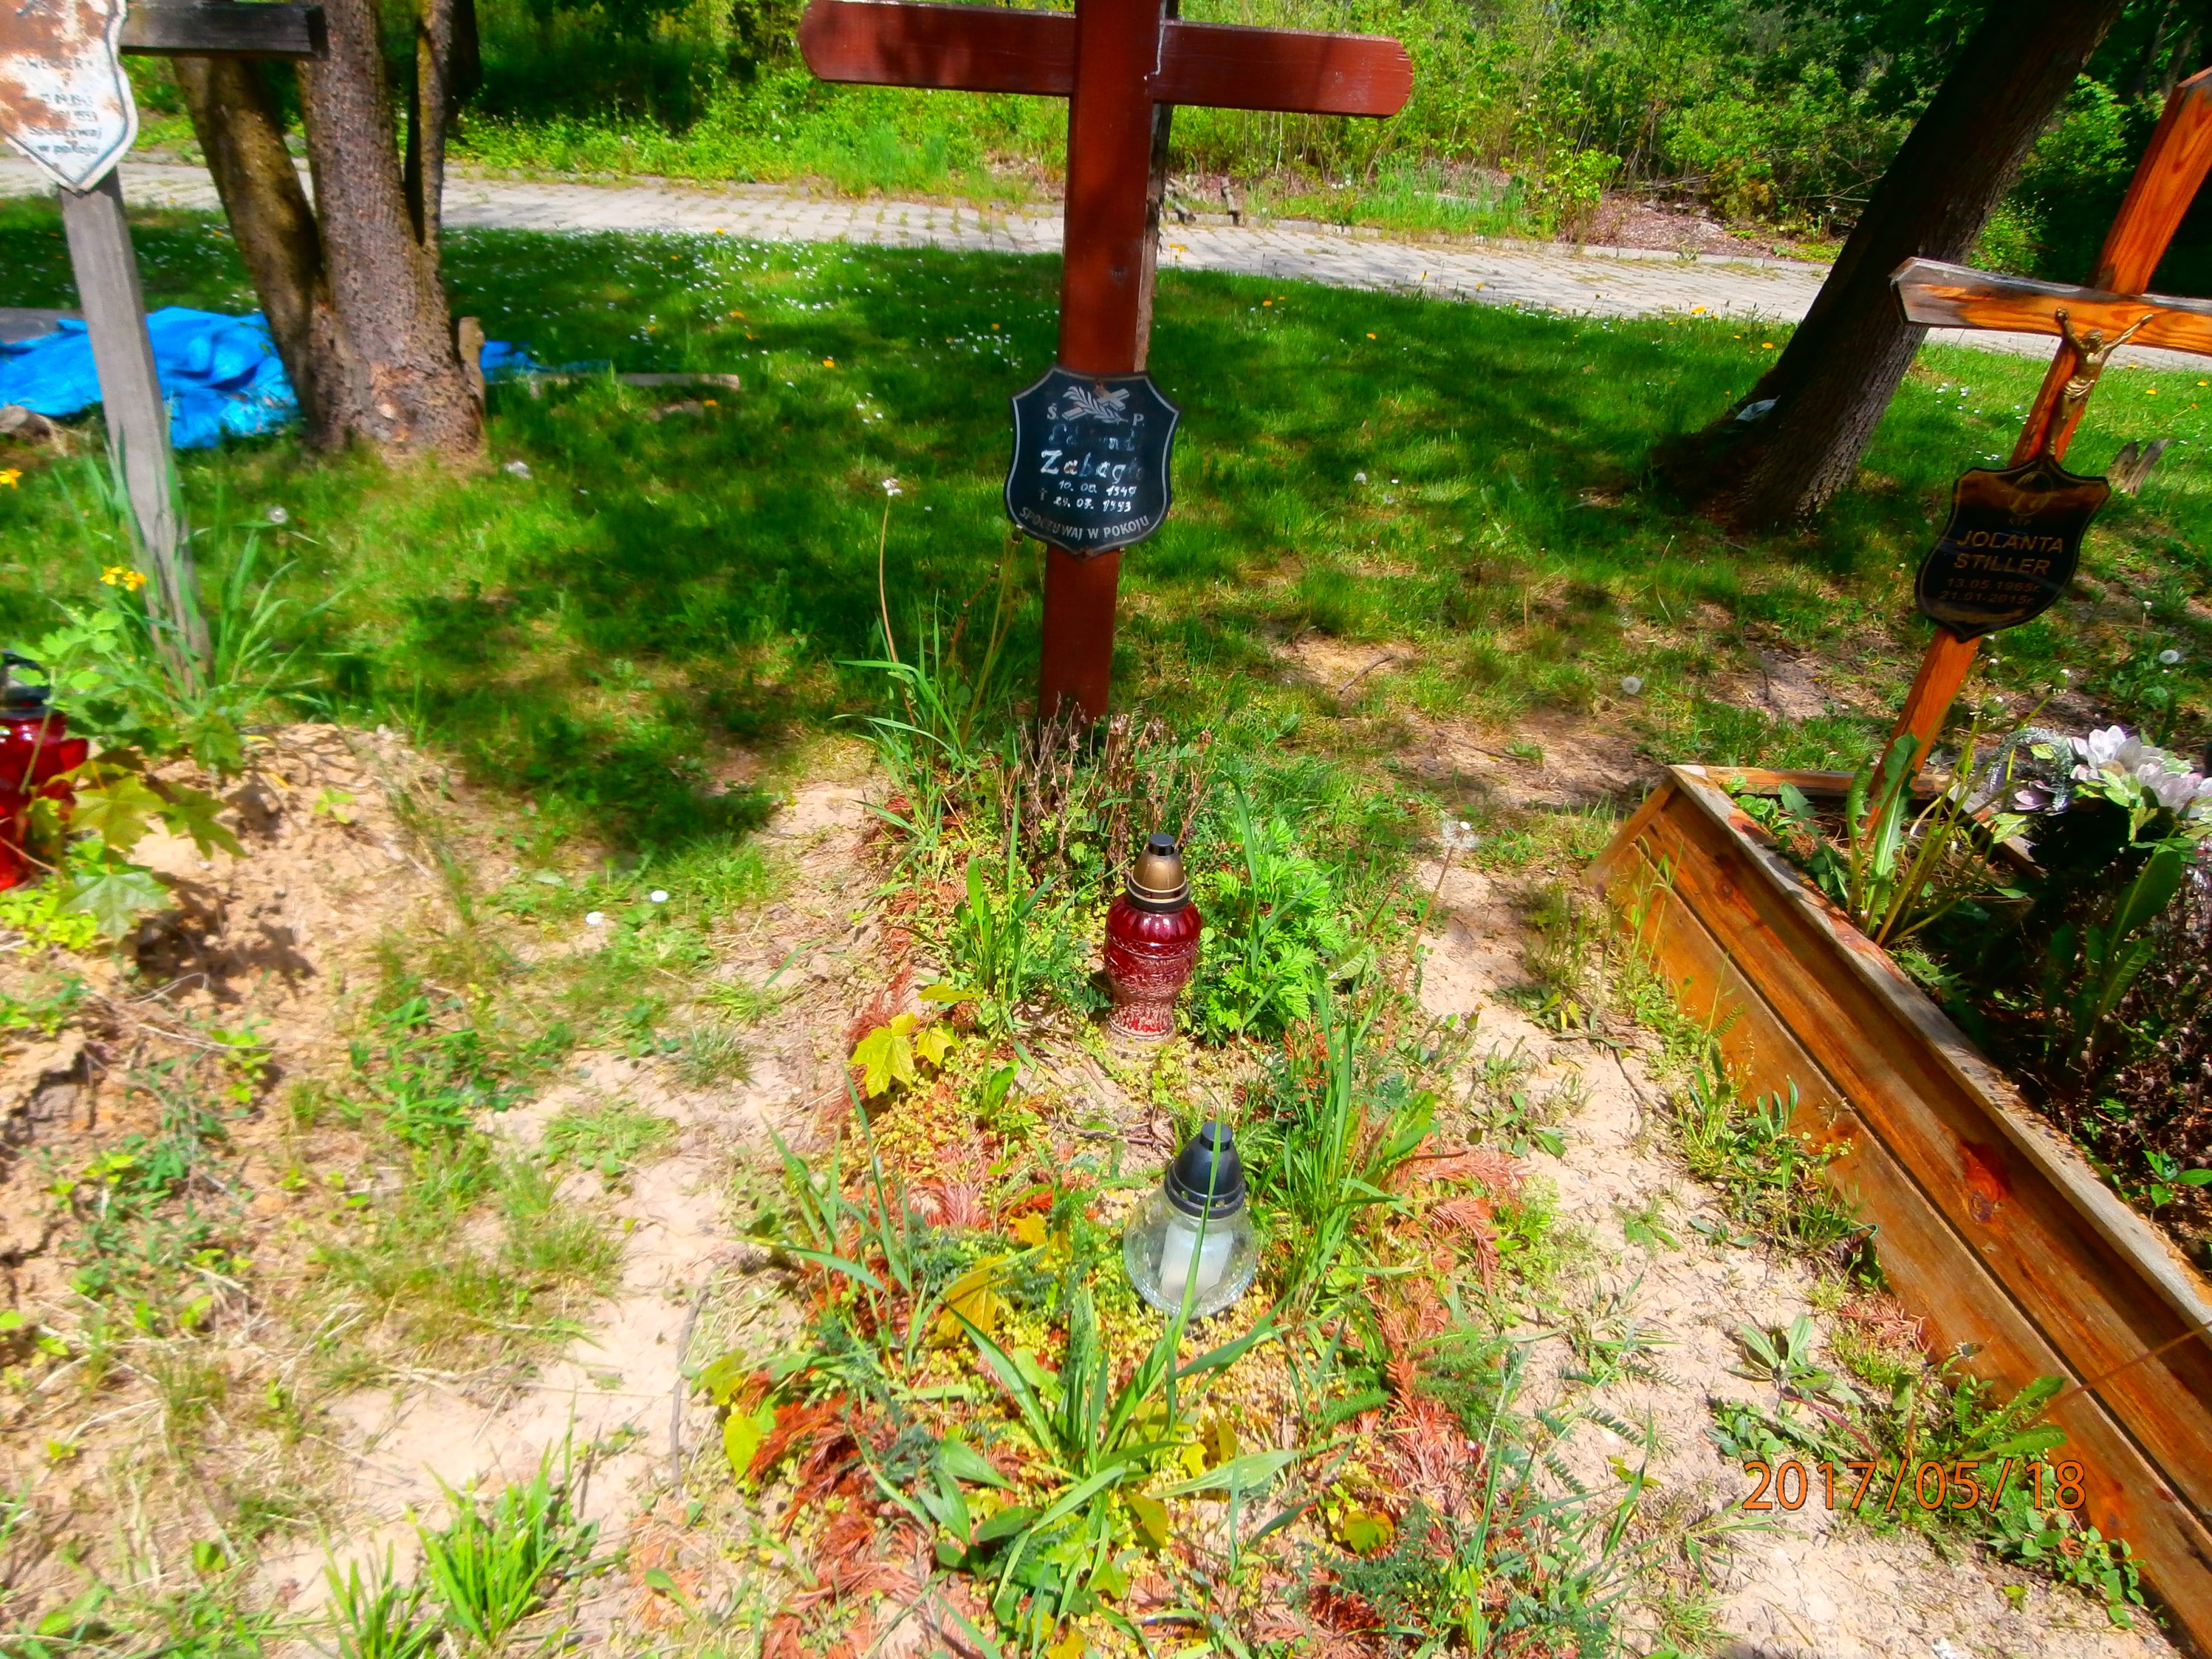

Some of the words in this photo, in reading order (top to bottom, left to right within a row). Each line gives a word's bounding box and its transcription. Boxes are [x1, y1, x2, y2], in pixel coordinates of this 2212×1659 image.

[1088, 527, 1099, 539] W
[1103, 514, 1150, 539] POKOJU
[1956, 530, 2064, 554] JOLANTA
[1953, 552, 2051, 575] STILLER
